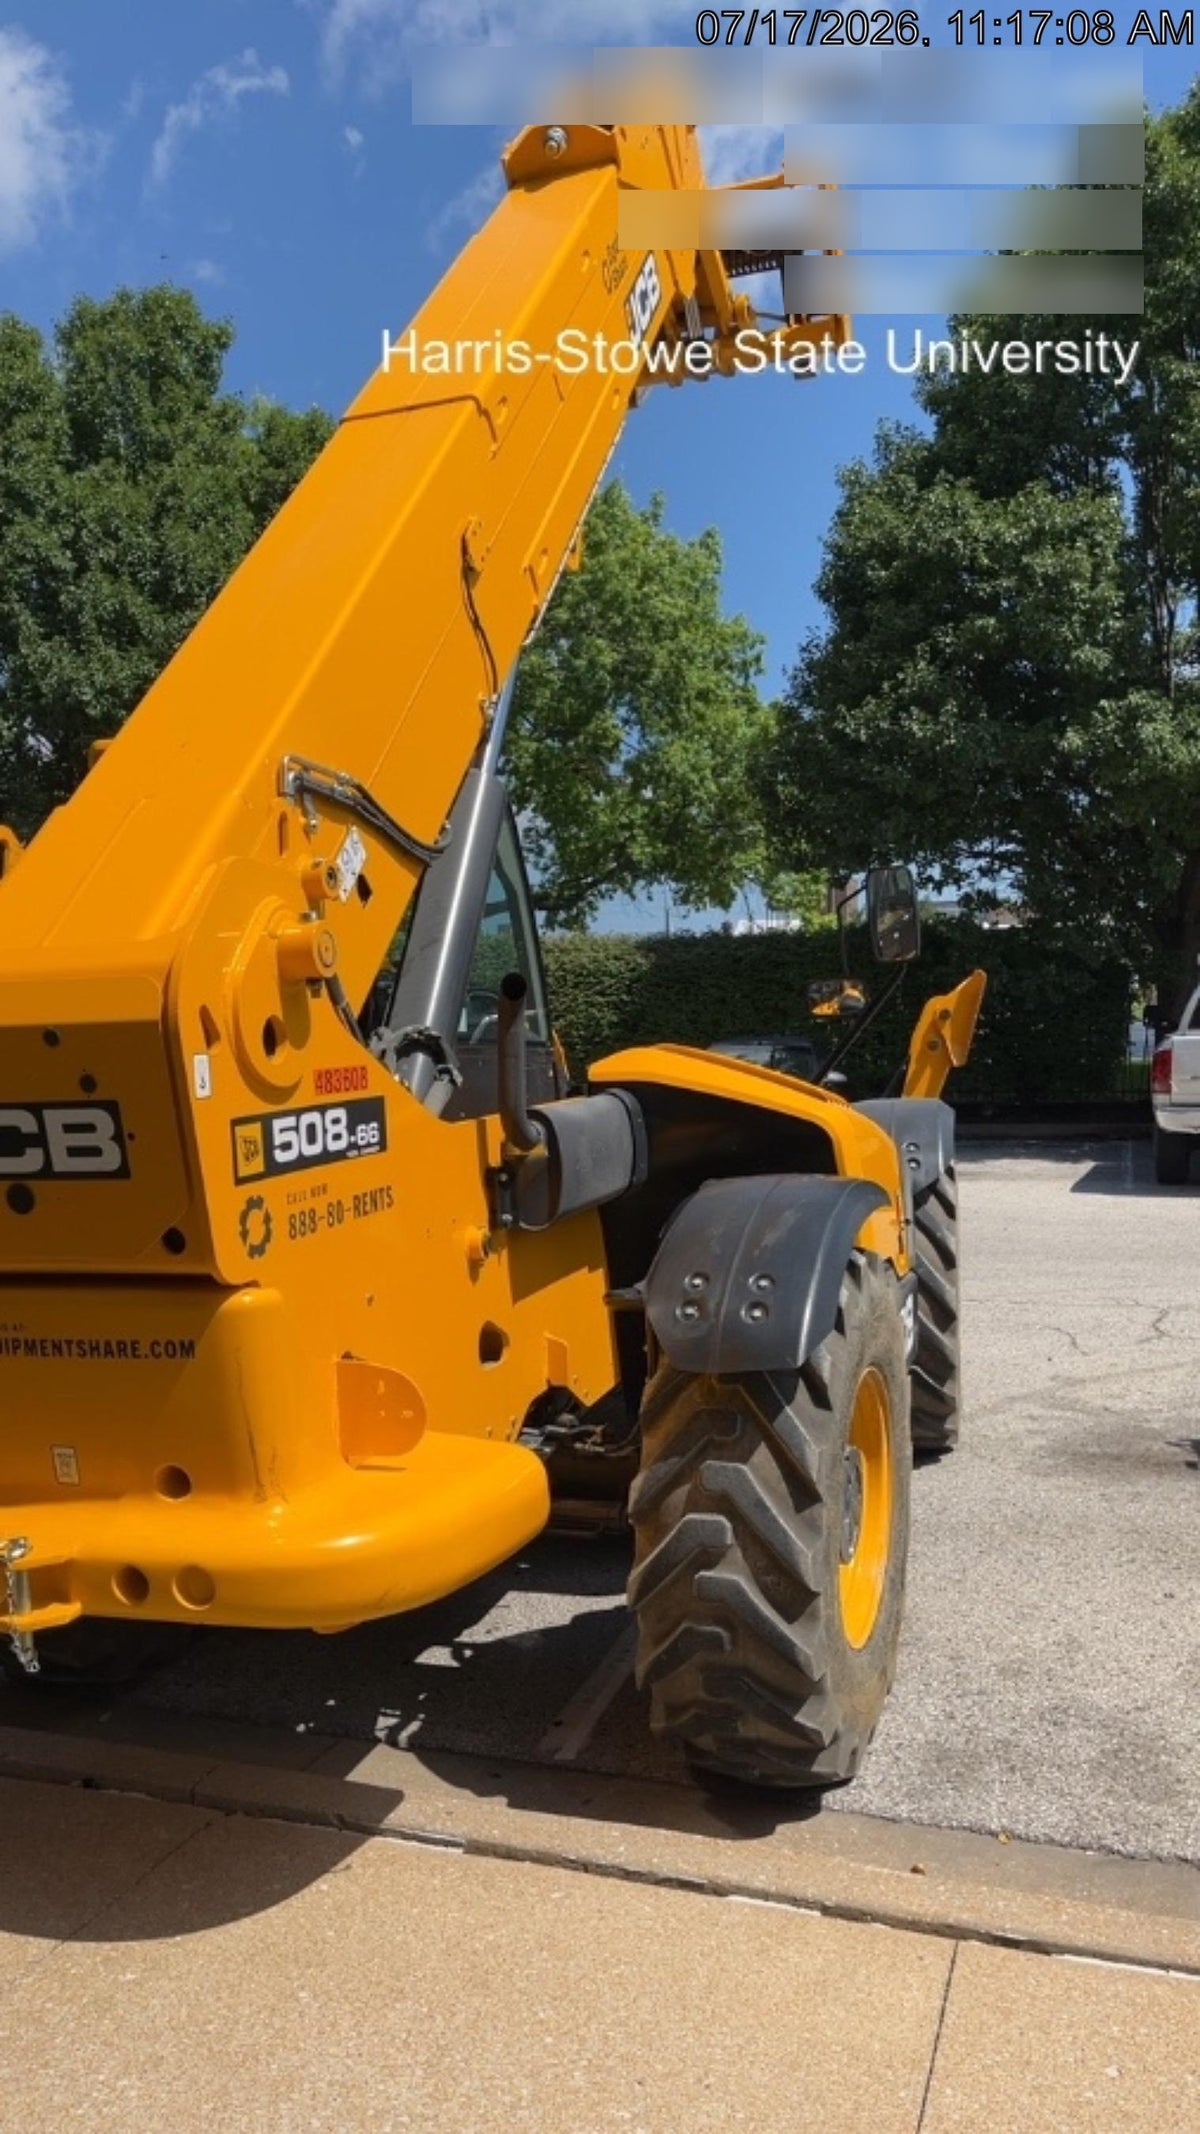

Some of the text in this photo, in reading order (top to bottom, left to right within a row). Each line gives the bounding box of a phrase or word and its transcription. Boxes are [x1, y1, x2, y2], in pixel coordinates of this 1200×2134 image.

[315, 1066, 368, 1094] 483608
[288, 1185, 394, 1241] 888-80-RENTS
[0, 1337, 196, 1360] IPMENTSHARE.COM
